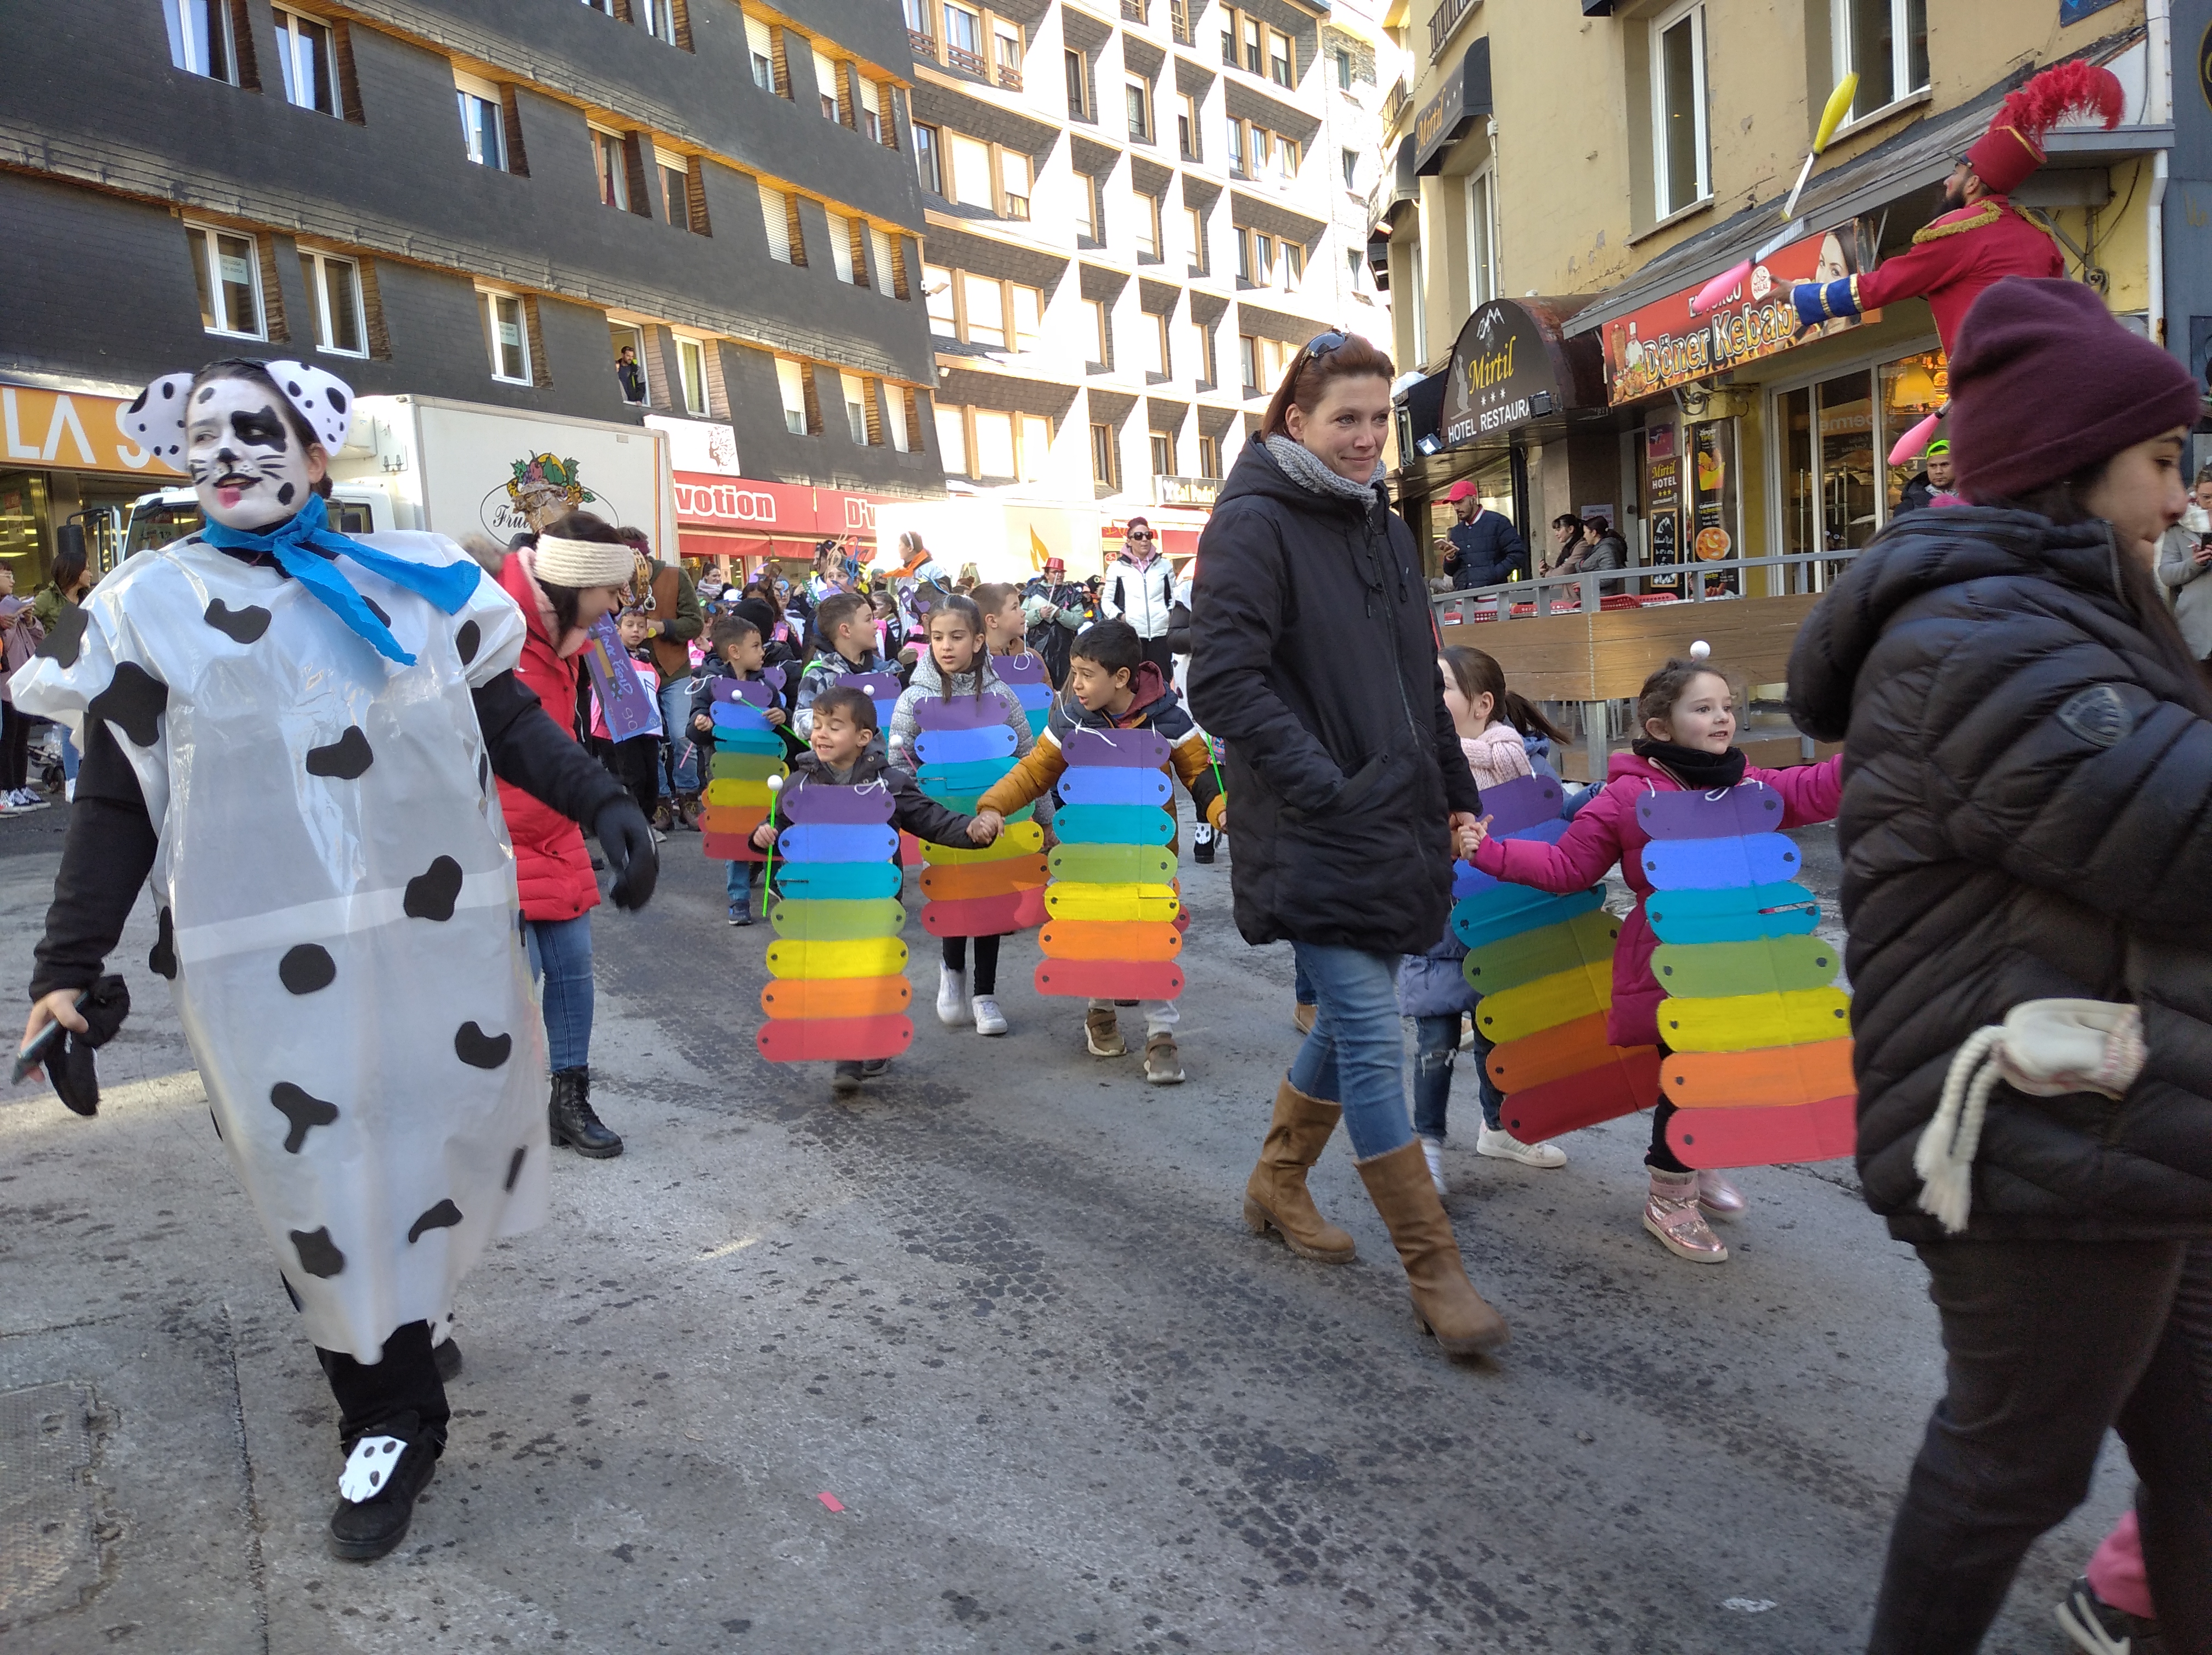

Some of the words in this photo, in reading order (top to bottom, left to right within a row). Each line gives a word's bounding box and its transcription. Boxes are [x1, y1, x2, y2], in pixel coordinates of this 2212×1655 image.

[1416, 87, 1446, 155] Mirtil
[1753, 282, 1769, 294] HALAL
[1468, 335, 1517, 395] Mirtil
[1643, 327, 1709, 384] Döner
[1712, 302, 1796, 360] Kebab
[2, 388, 97, 464] LA
[1448, 418, 1477, 444] HOTEL
[1480, 390, 1547, 432] RESTAURA
[1652, 460, 1677, 478] Mirtil
[1652, 476, 1678, 490] HOTEL
[675, 485, 777, 522] votion
[622, 707, 639, 731] 90
